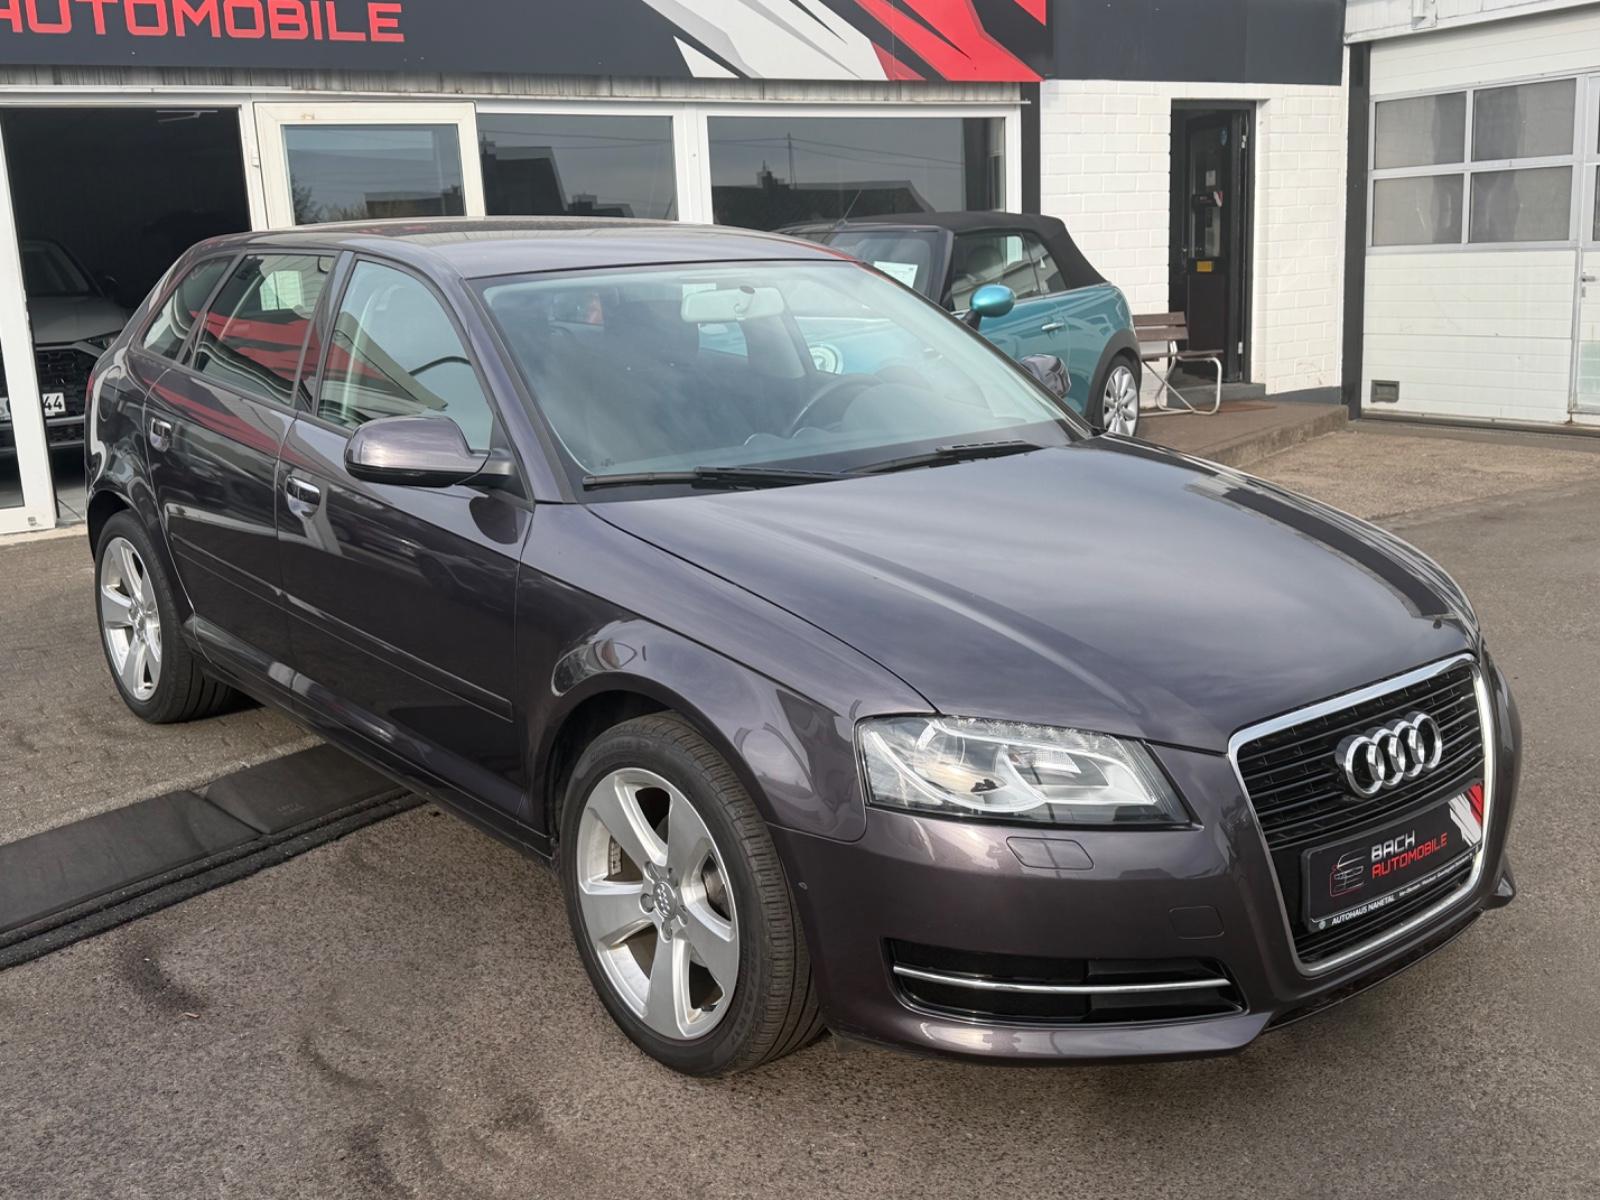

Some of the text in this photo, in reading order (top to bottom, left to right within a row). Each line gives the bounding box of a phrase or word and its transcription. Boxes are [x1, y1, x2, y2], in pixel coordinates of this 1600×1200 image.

[1371, 829, 1415, 862] BACH
[1371, 832, 1448, 879] AUTOMOBILE
[1331, 906, 1368, 925] AUTOHAUS
